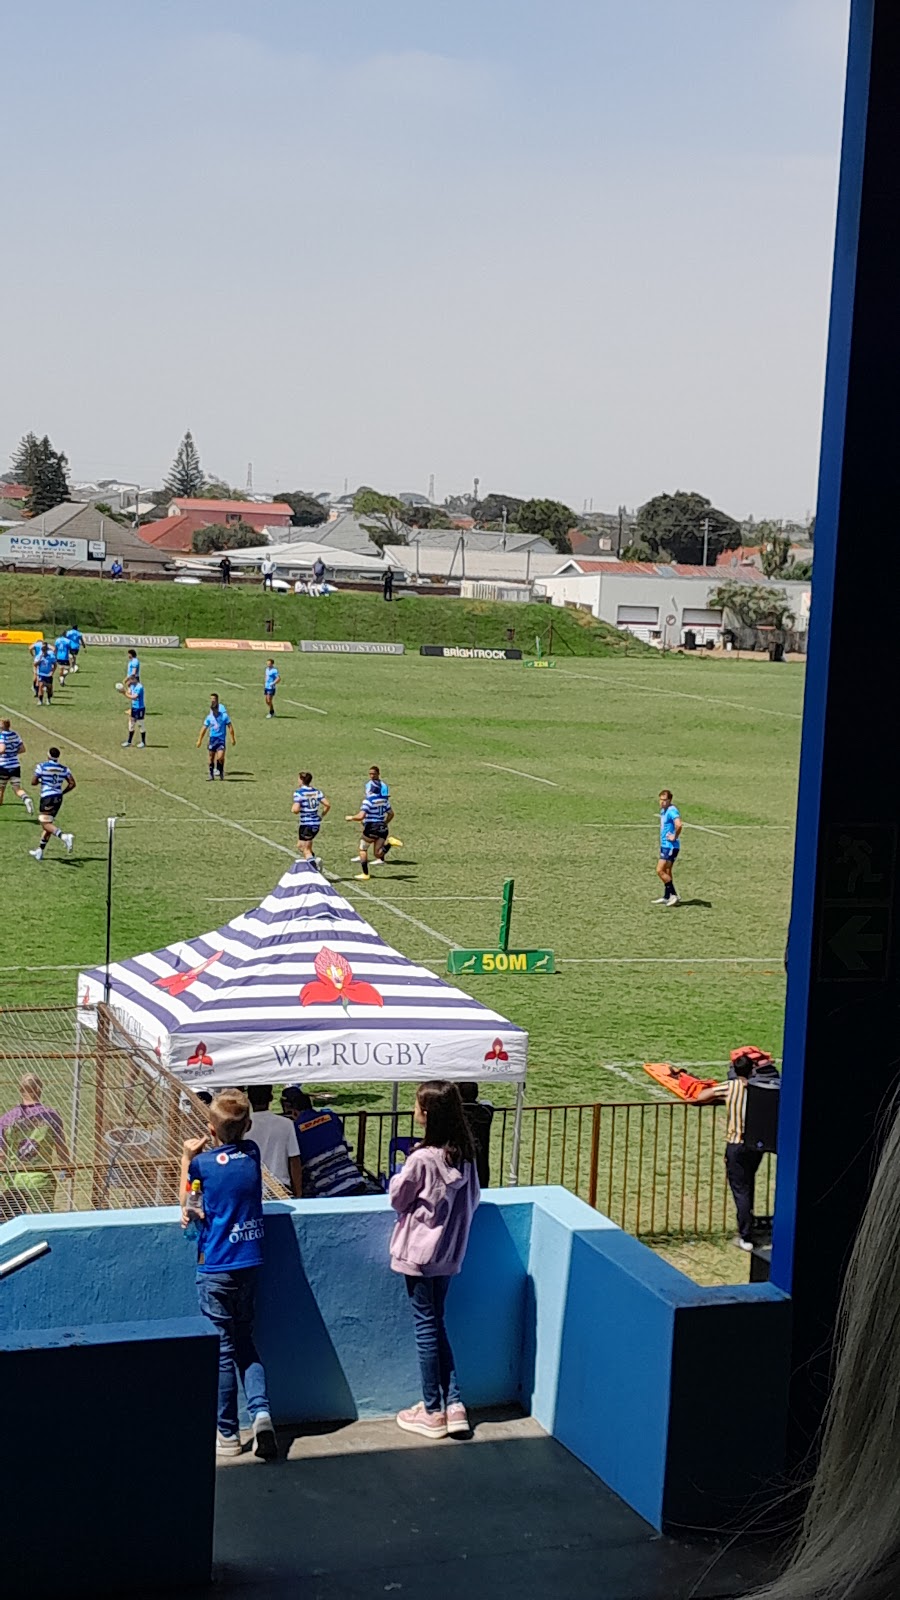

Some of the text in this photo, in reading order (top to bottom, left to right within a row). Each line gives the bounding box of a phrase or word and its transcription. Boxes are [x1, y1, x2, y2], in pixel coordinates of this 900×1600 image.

[10, 537, 76, 548] NORTONS
[129, 637, 170, 646] STADIO
[312, 642, 397, 654] STADIO STADIO
[443, 647, 507, 660] BRIGHTROCK
[482, 953, 527, 971] 50M
[271, 1042, 431, 1067] W.P. RUGBY
